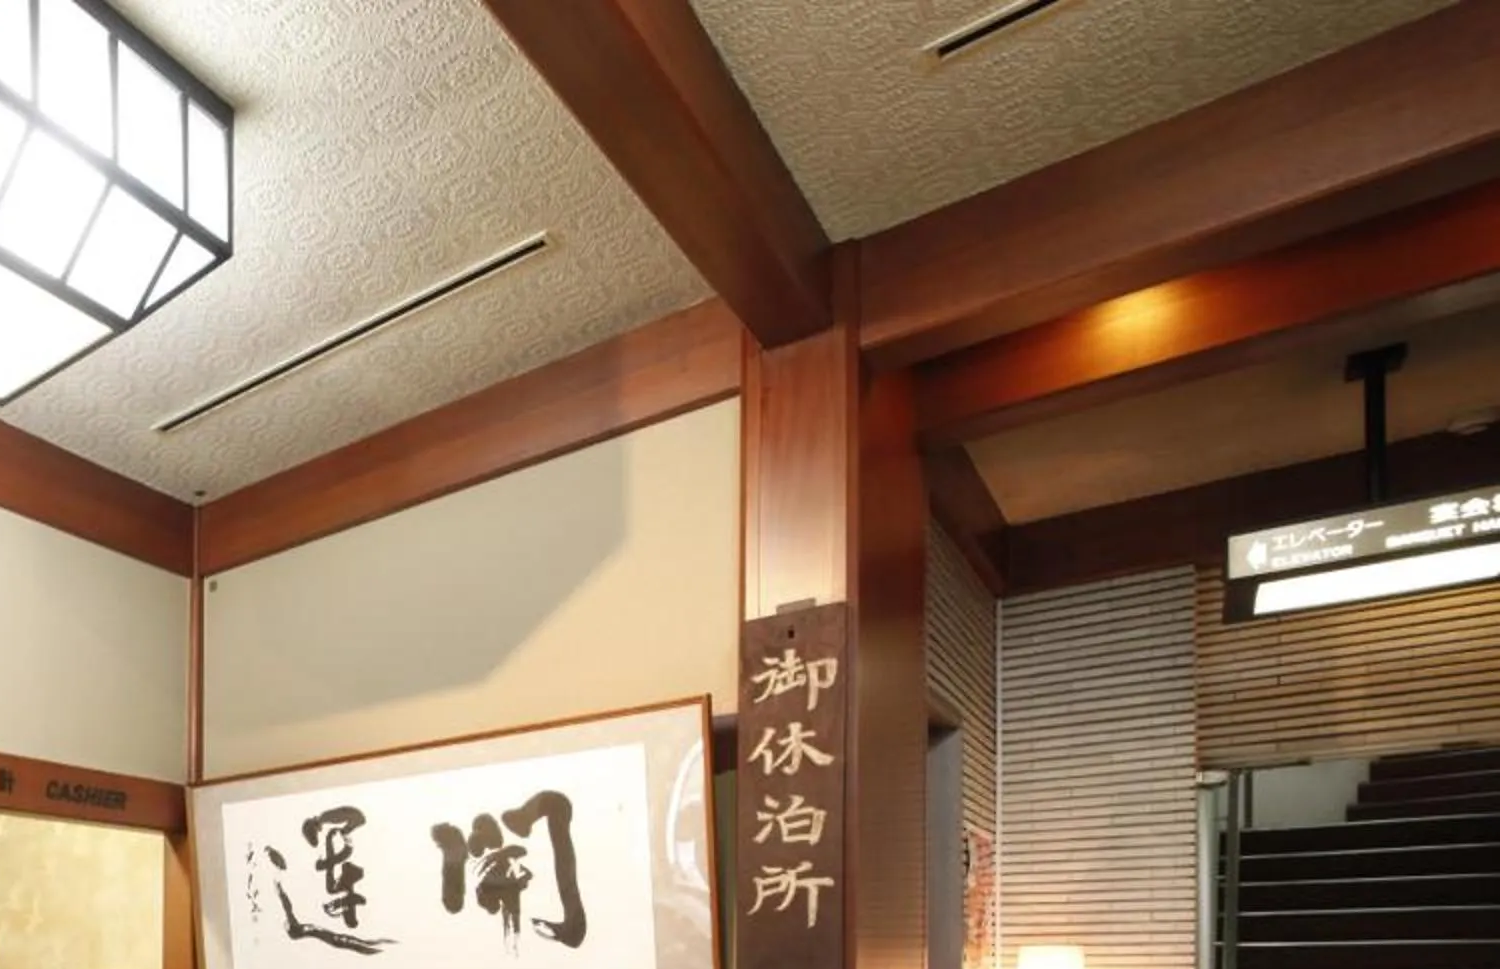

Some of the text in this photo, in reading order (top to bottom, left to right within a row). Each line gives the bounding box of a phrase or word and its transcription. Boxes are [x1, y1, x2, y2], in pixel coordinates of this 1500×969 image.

[1271, 519, 1384, 552] エレベーター
[45, 779, 127, 811] CASHIER
[747, 648, 838, 929] 御休泊所
